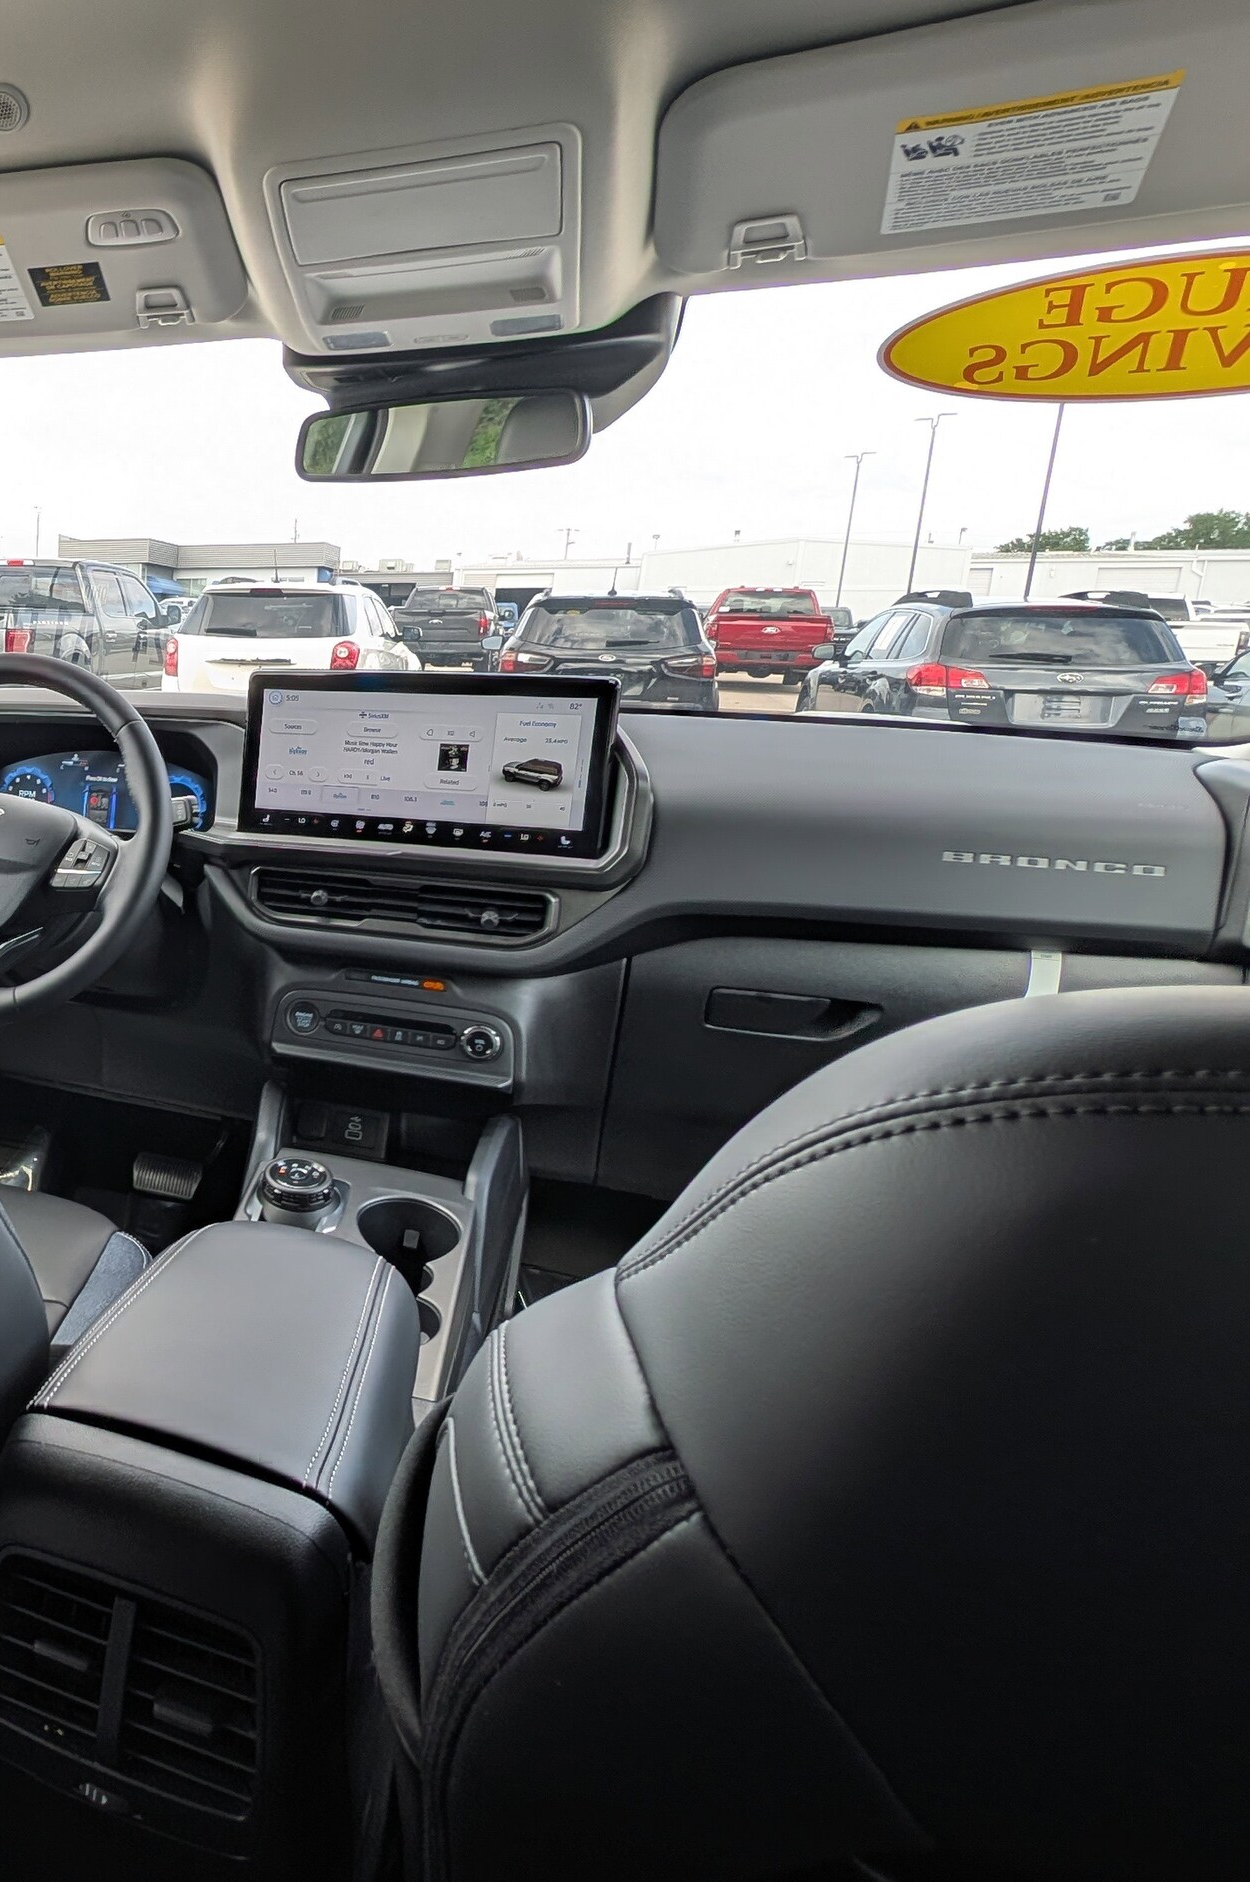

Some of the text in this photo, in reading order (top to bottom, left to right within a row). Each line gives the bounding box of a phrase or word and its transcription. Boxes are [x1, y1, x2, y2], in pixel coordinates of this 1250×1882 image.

[531, 720, 557, 728] Economy
[18, 790, 36, 798] RPM
[942, 850, 1167, 877] BRONCO
